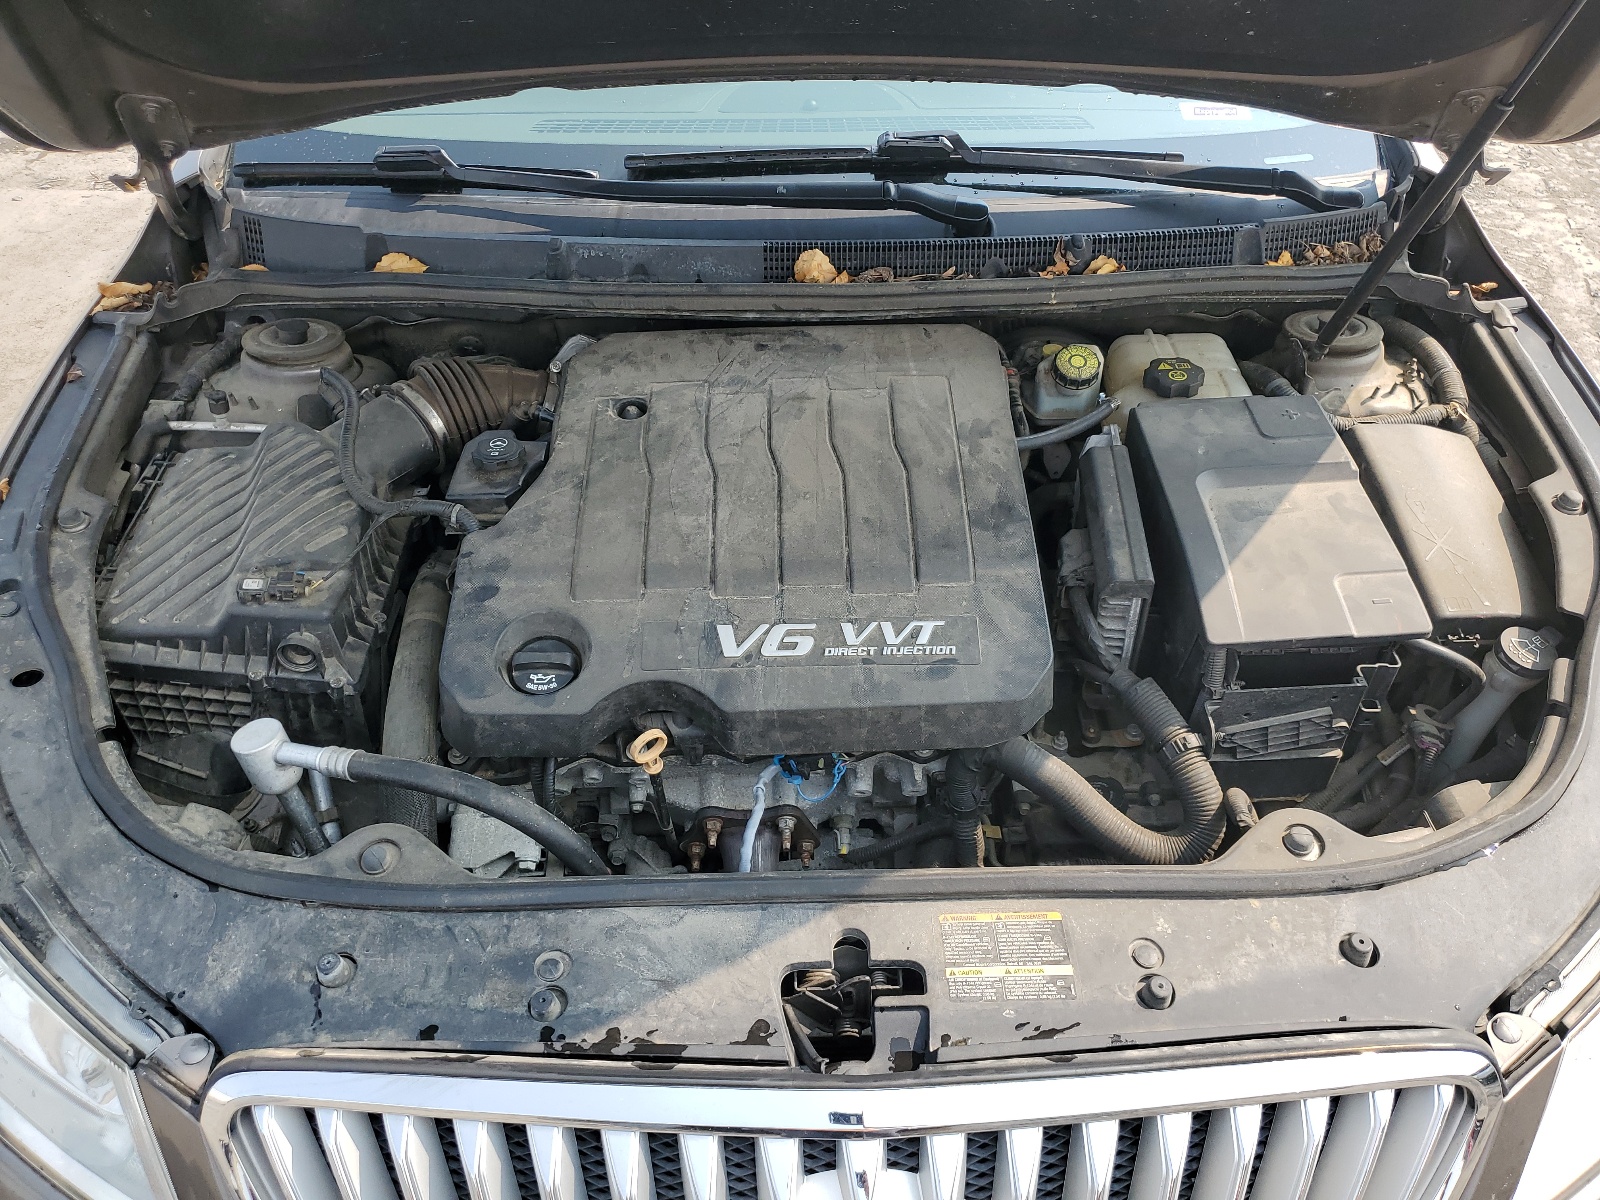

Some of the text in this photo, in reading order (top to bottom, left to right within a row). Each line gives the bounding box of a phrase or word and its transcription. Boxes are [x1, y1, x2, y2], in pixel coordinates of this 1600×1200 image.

[717, 621, 945, 657] V6 VVT
[825, 646, 956, 656] DIRECT INJECTION
[526, 682, 538, 690] SAE
